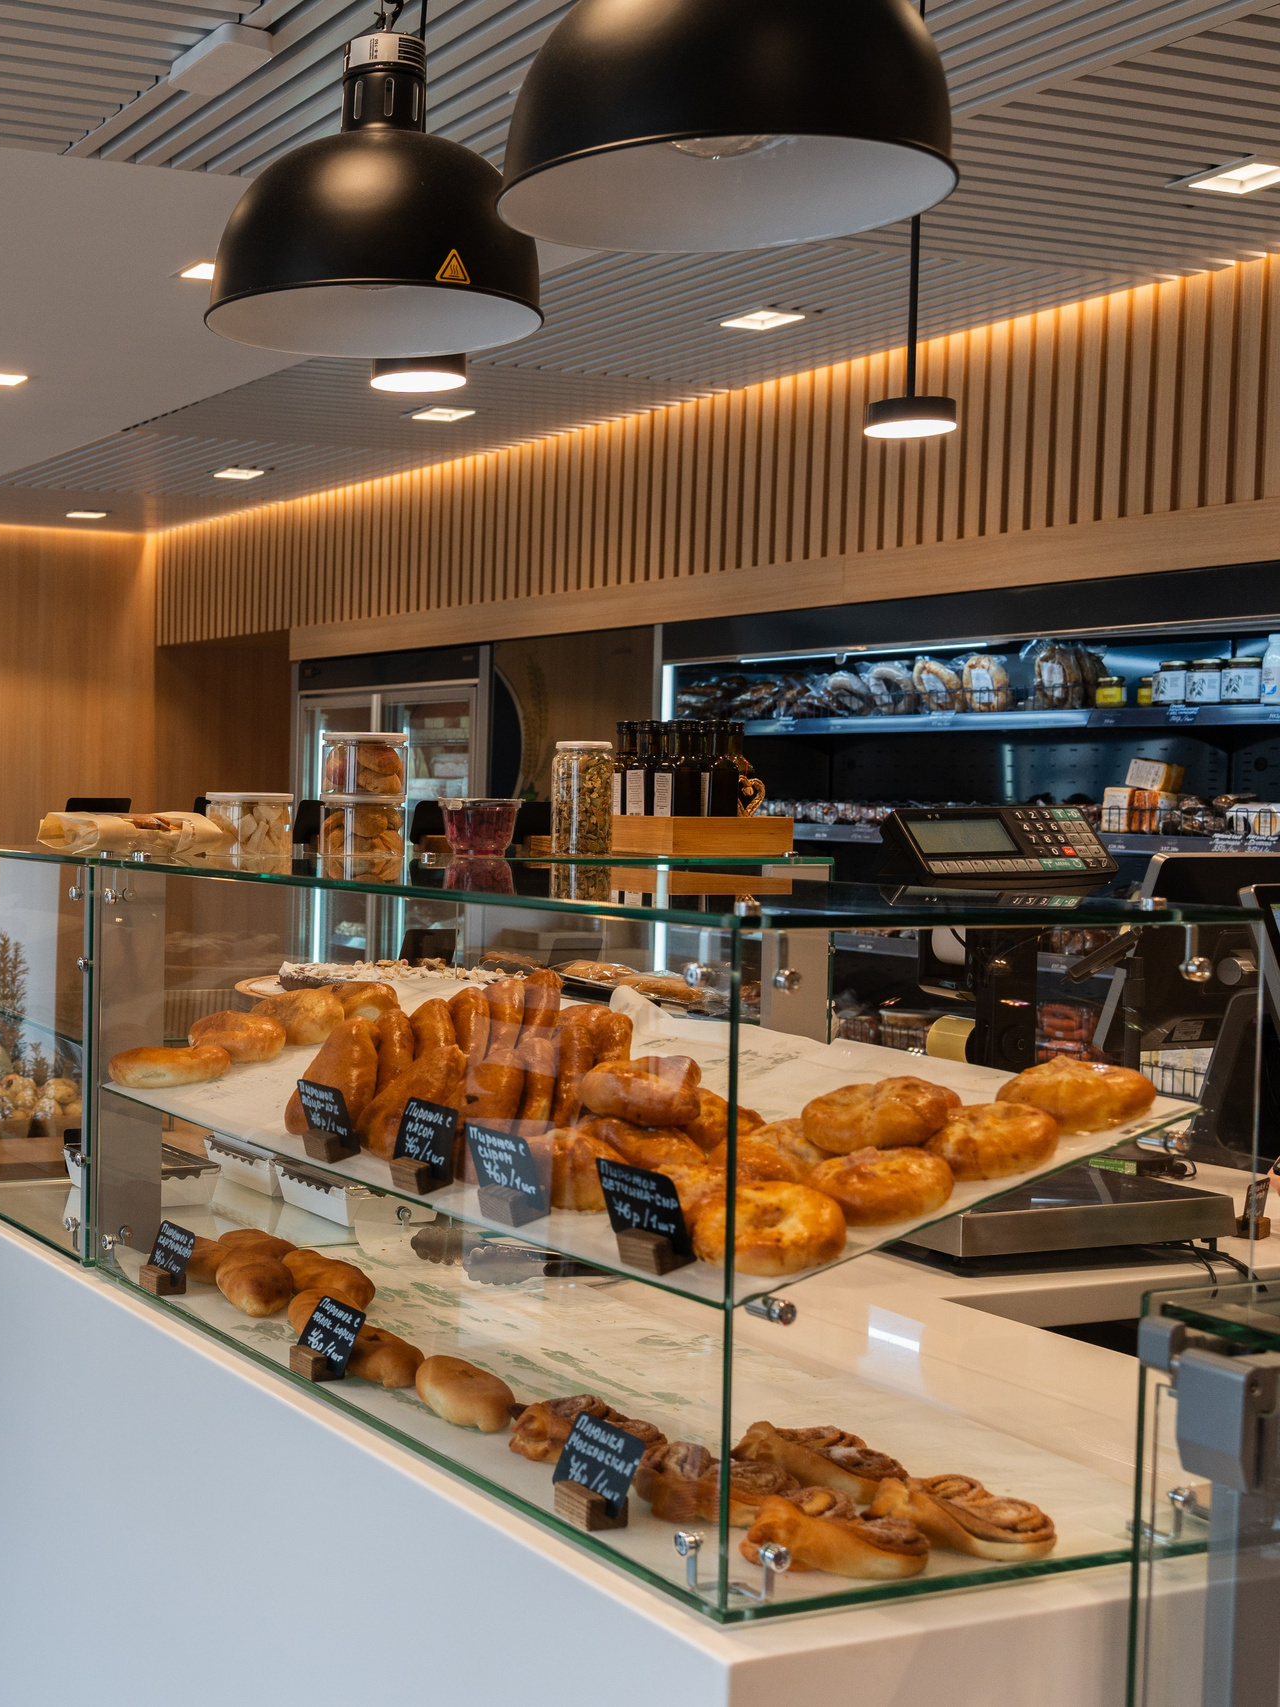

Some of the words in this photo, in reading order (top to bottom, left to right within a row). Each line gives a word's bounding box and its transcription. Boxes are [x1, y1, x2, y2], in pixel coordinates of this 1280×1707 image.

[1015, 811, 1022, 819] 1
[1028, 811, 1037, 819] 2
[1042, 811, 1051, 819] 3
[1055, 810, 1063, 818] T
[1023, 823, 1030, 831] 4
[1036, 823, 1044, 831] 5
[1050, 823, 1058, 831] 6
[1029, 835, 1036, 843] 7
[1043, 835, 1052, 843] 8
[1057, 835, 1065, 843] 9
[1051, 848, 1059, 856] 0
[405, 1102, 443, 1125] Пирожок
[469, 1126, 516, 1152] Пирожок
[319, 1297, 353, 1324] Пирожок
